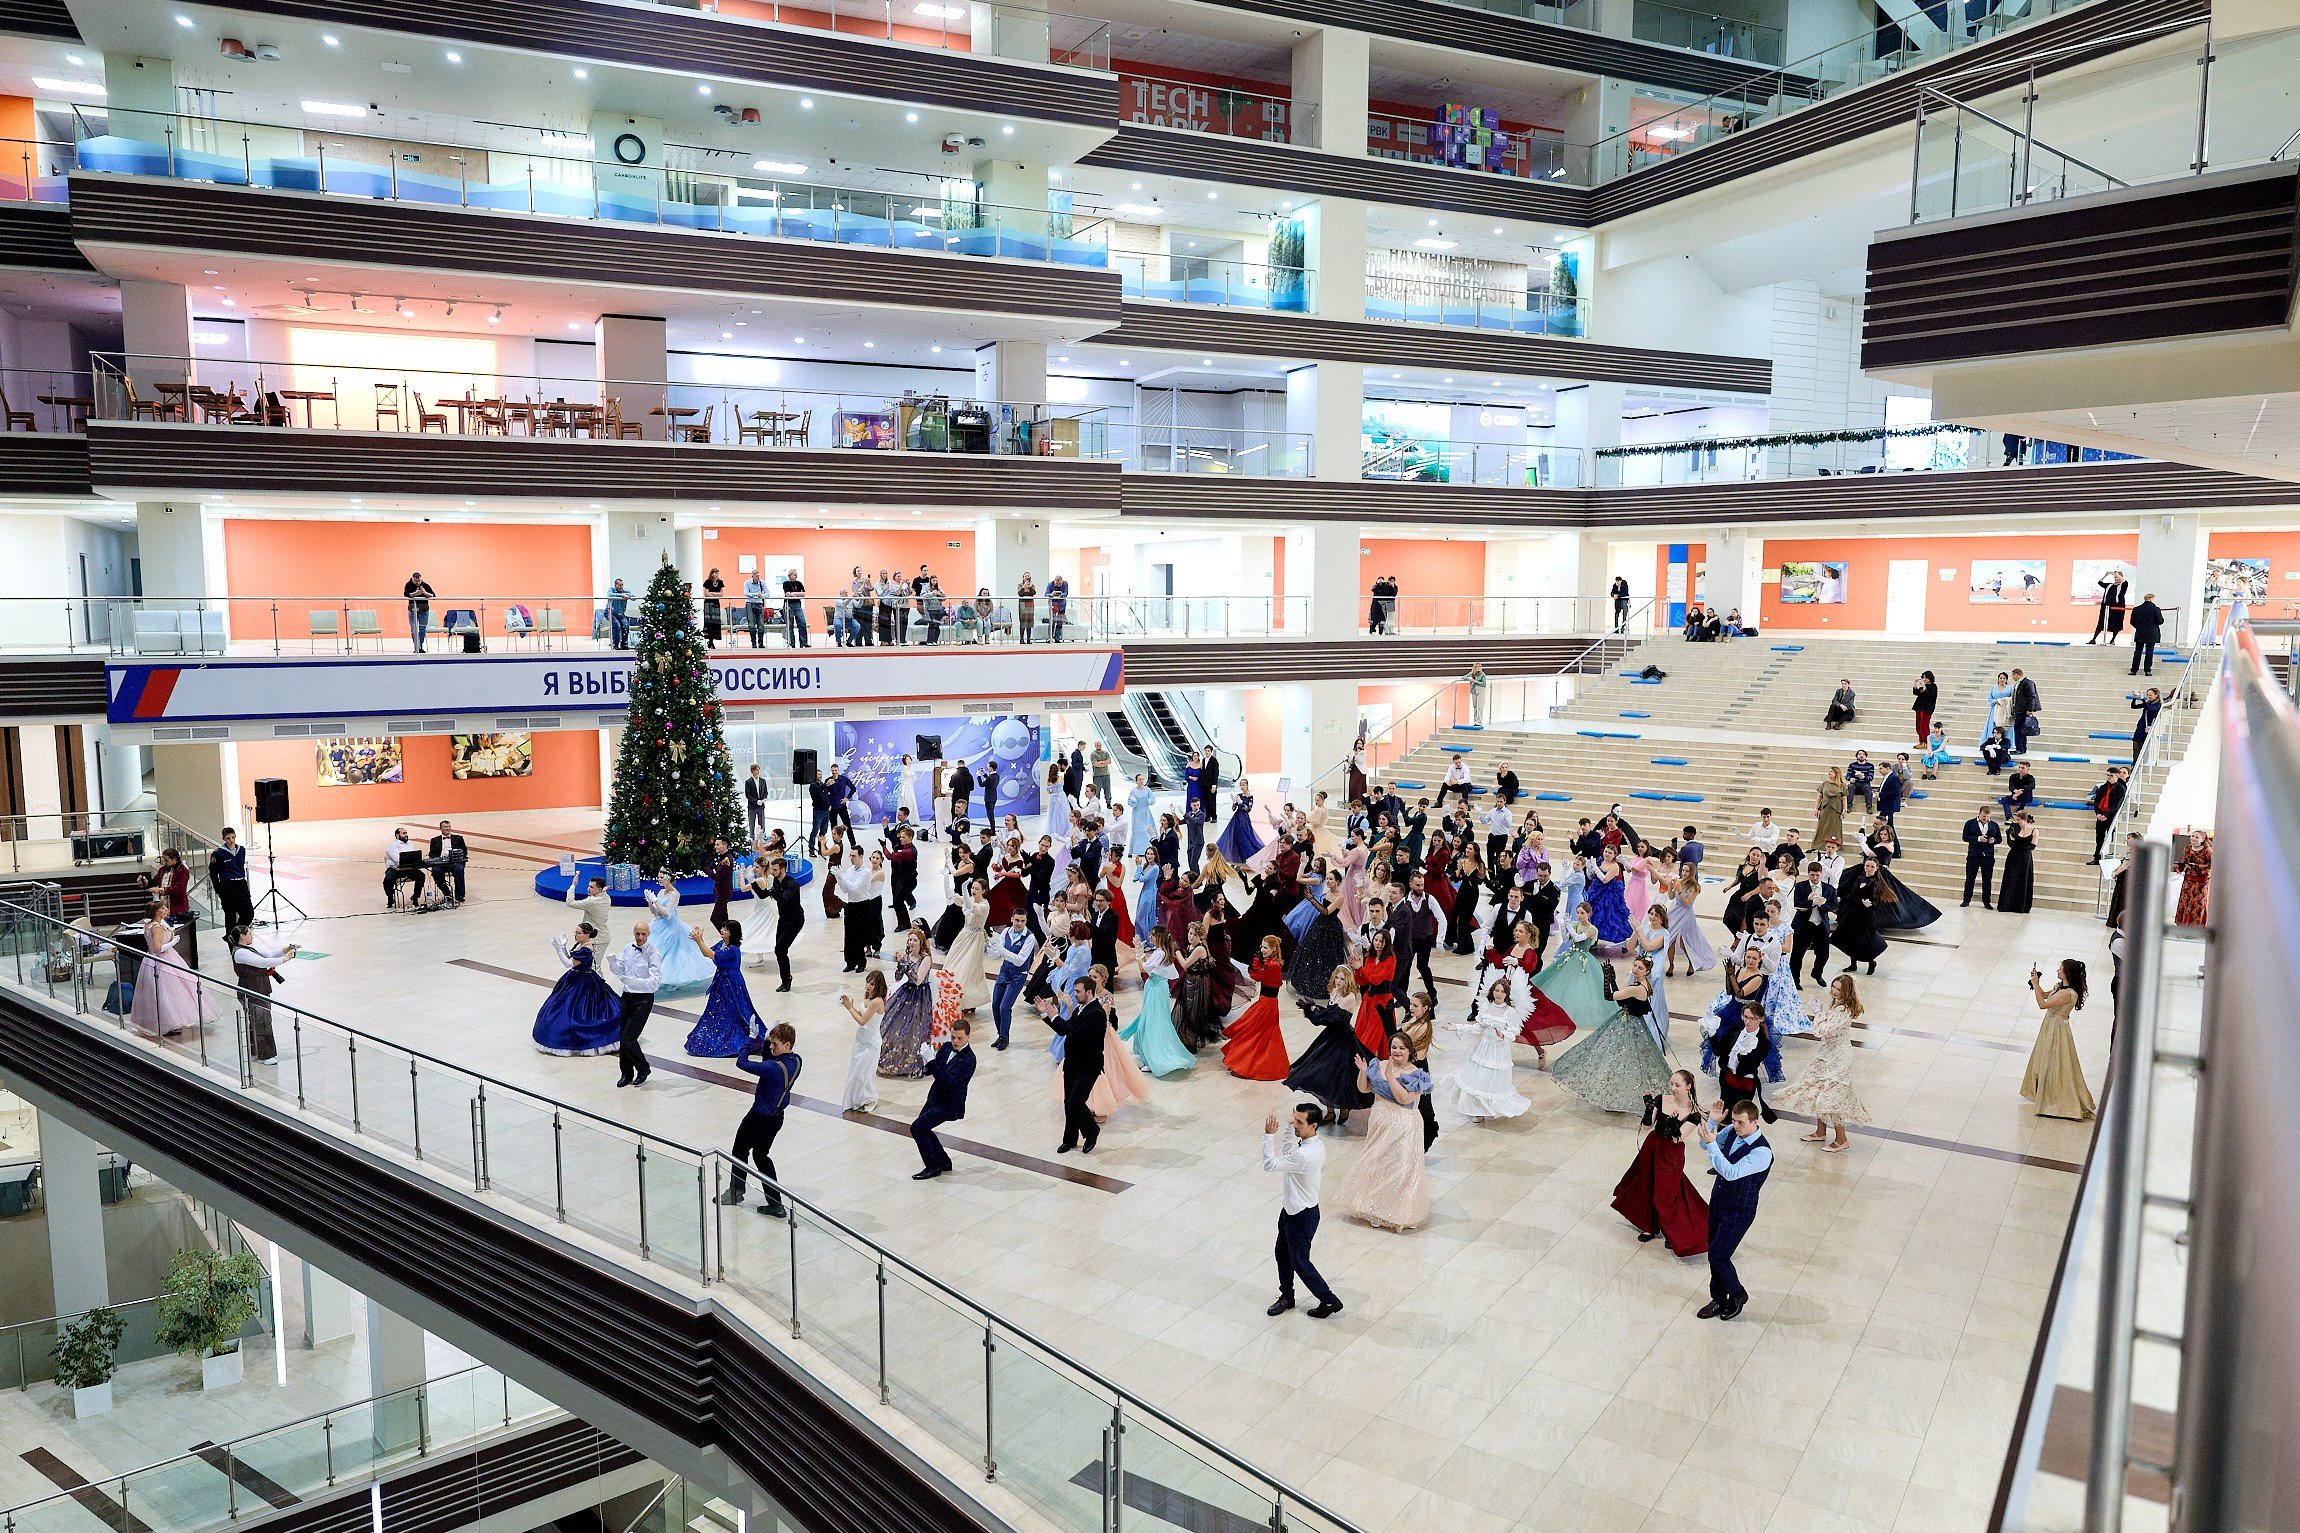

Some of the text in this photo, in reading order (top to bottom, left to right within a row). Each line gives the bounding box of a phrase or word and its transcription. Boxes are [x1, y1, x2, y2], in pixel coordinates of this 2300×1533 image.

[1131, 81, 1209, 117] TECH
[543, 672, 559, 696] Я
[710, 666, 822, 691] РОССИЮ!
[878, 762, 902, 774] 202
